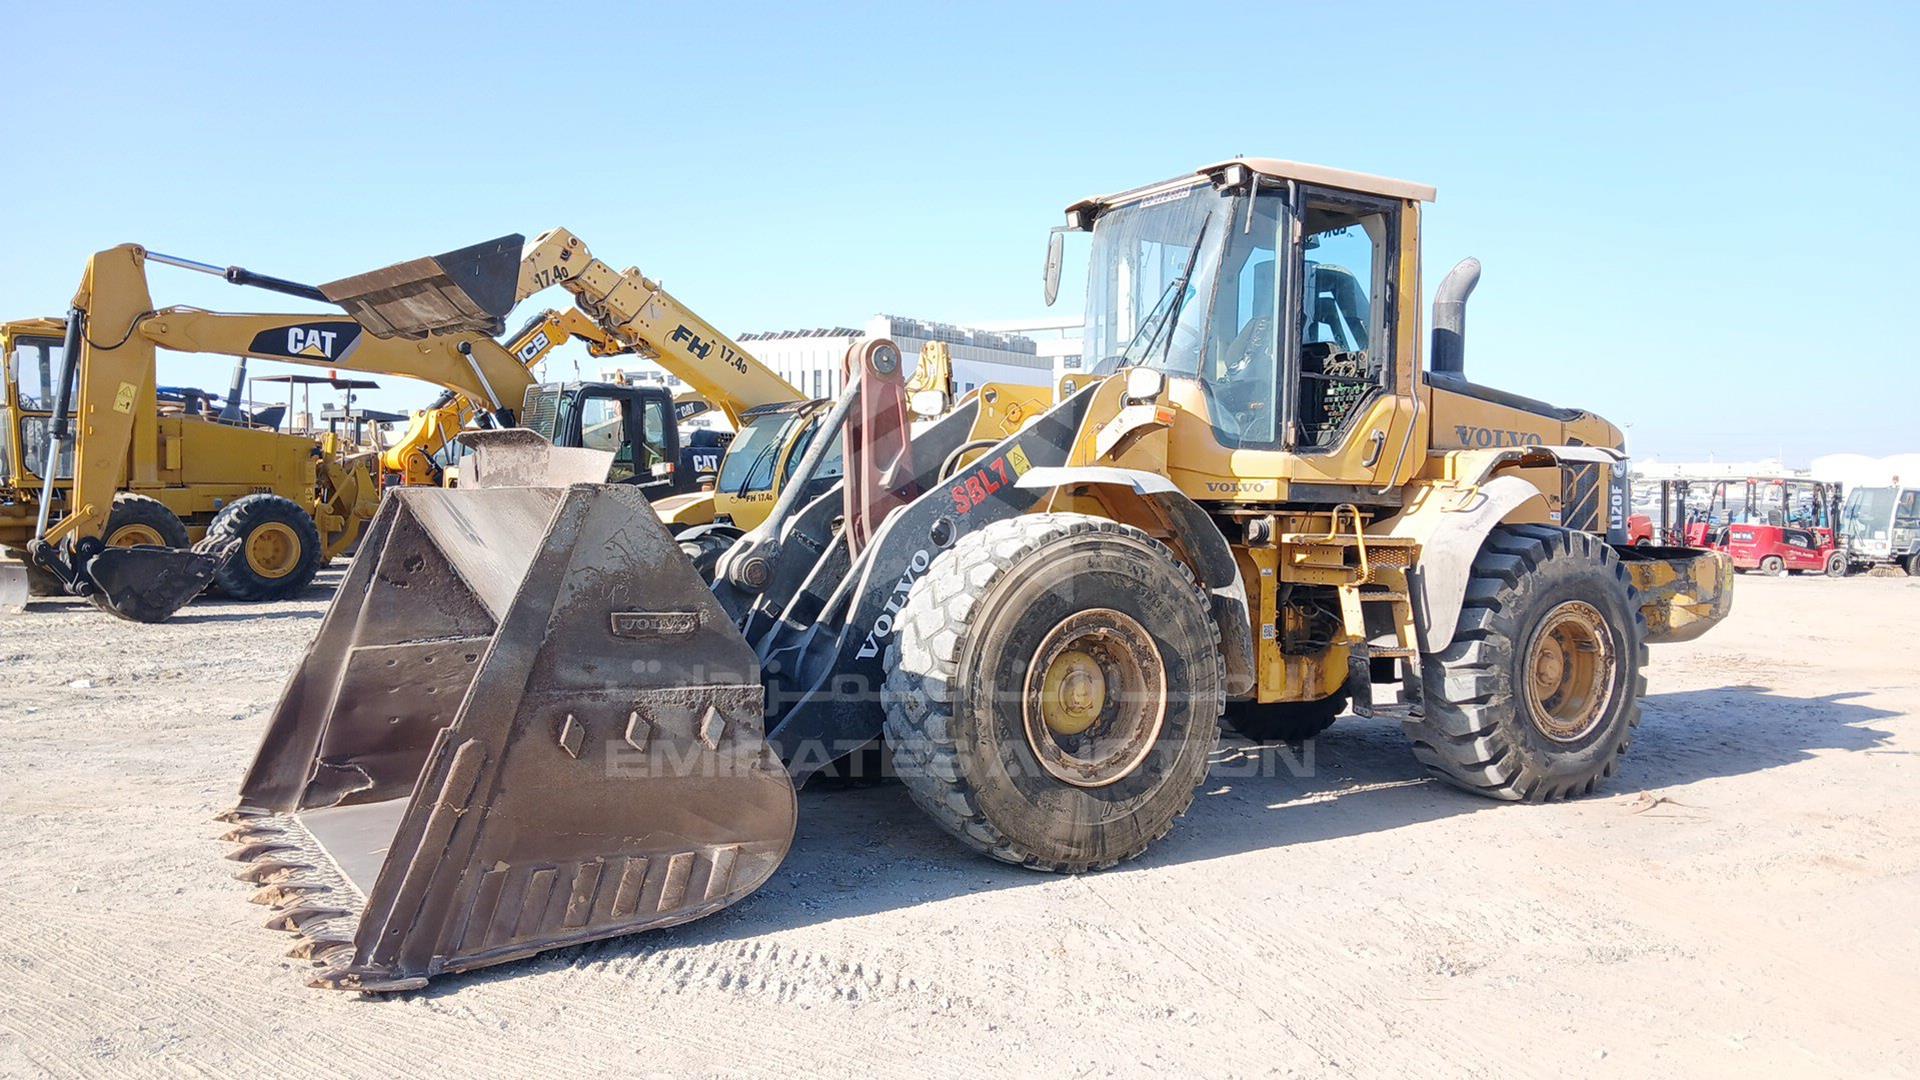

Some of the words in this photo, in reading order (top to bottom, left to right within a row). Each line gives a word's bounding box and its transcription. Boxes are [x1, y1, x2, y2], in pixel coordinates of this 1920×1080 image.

[535, 265, 569, 288] 17.40
[287, 327, 337, 358] CAT
[672, 324, 711, 360] FH
[720, 344, 748, 375] 17.40
[681, 403, 695, 417] CAT
[1454, 425, 1543, 448] VOLVO
[693, 455, 718, 473] CAT
[1205, 482, 1265, 493] VOLVO
[1611, 485, 1623, 530] L120F
[854, 549, 930, 661] VOLVO
